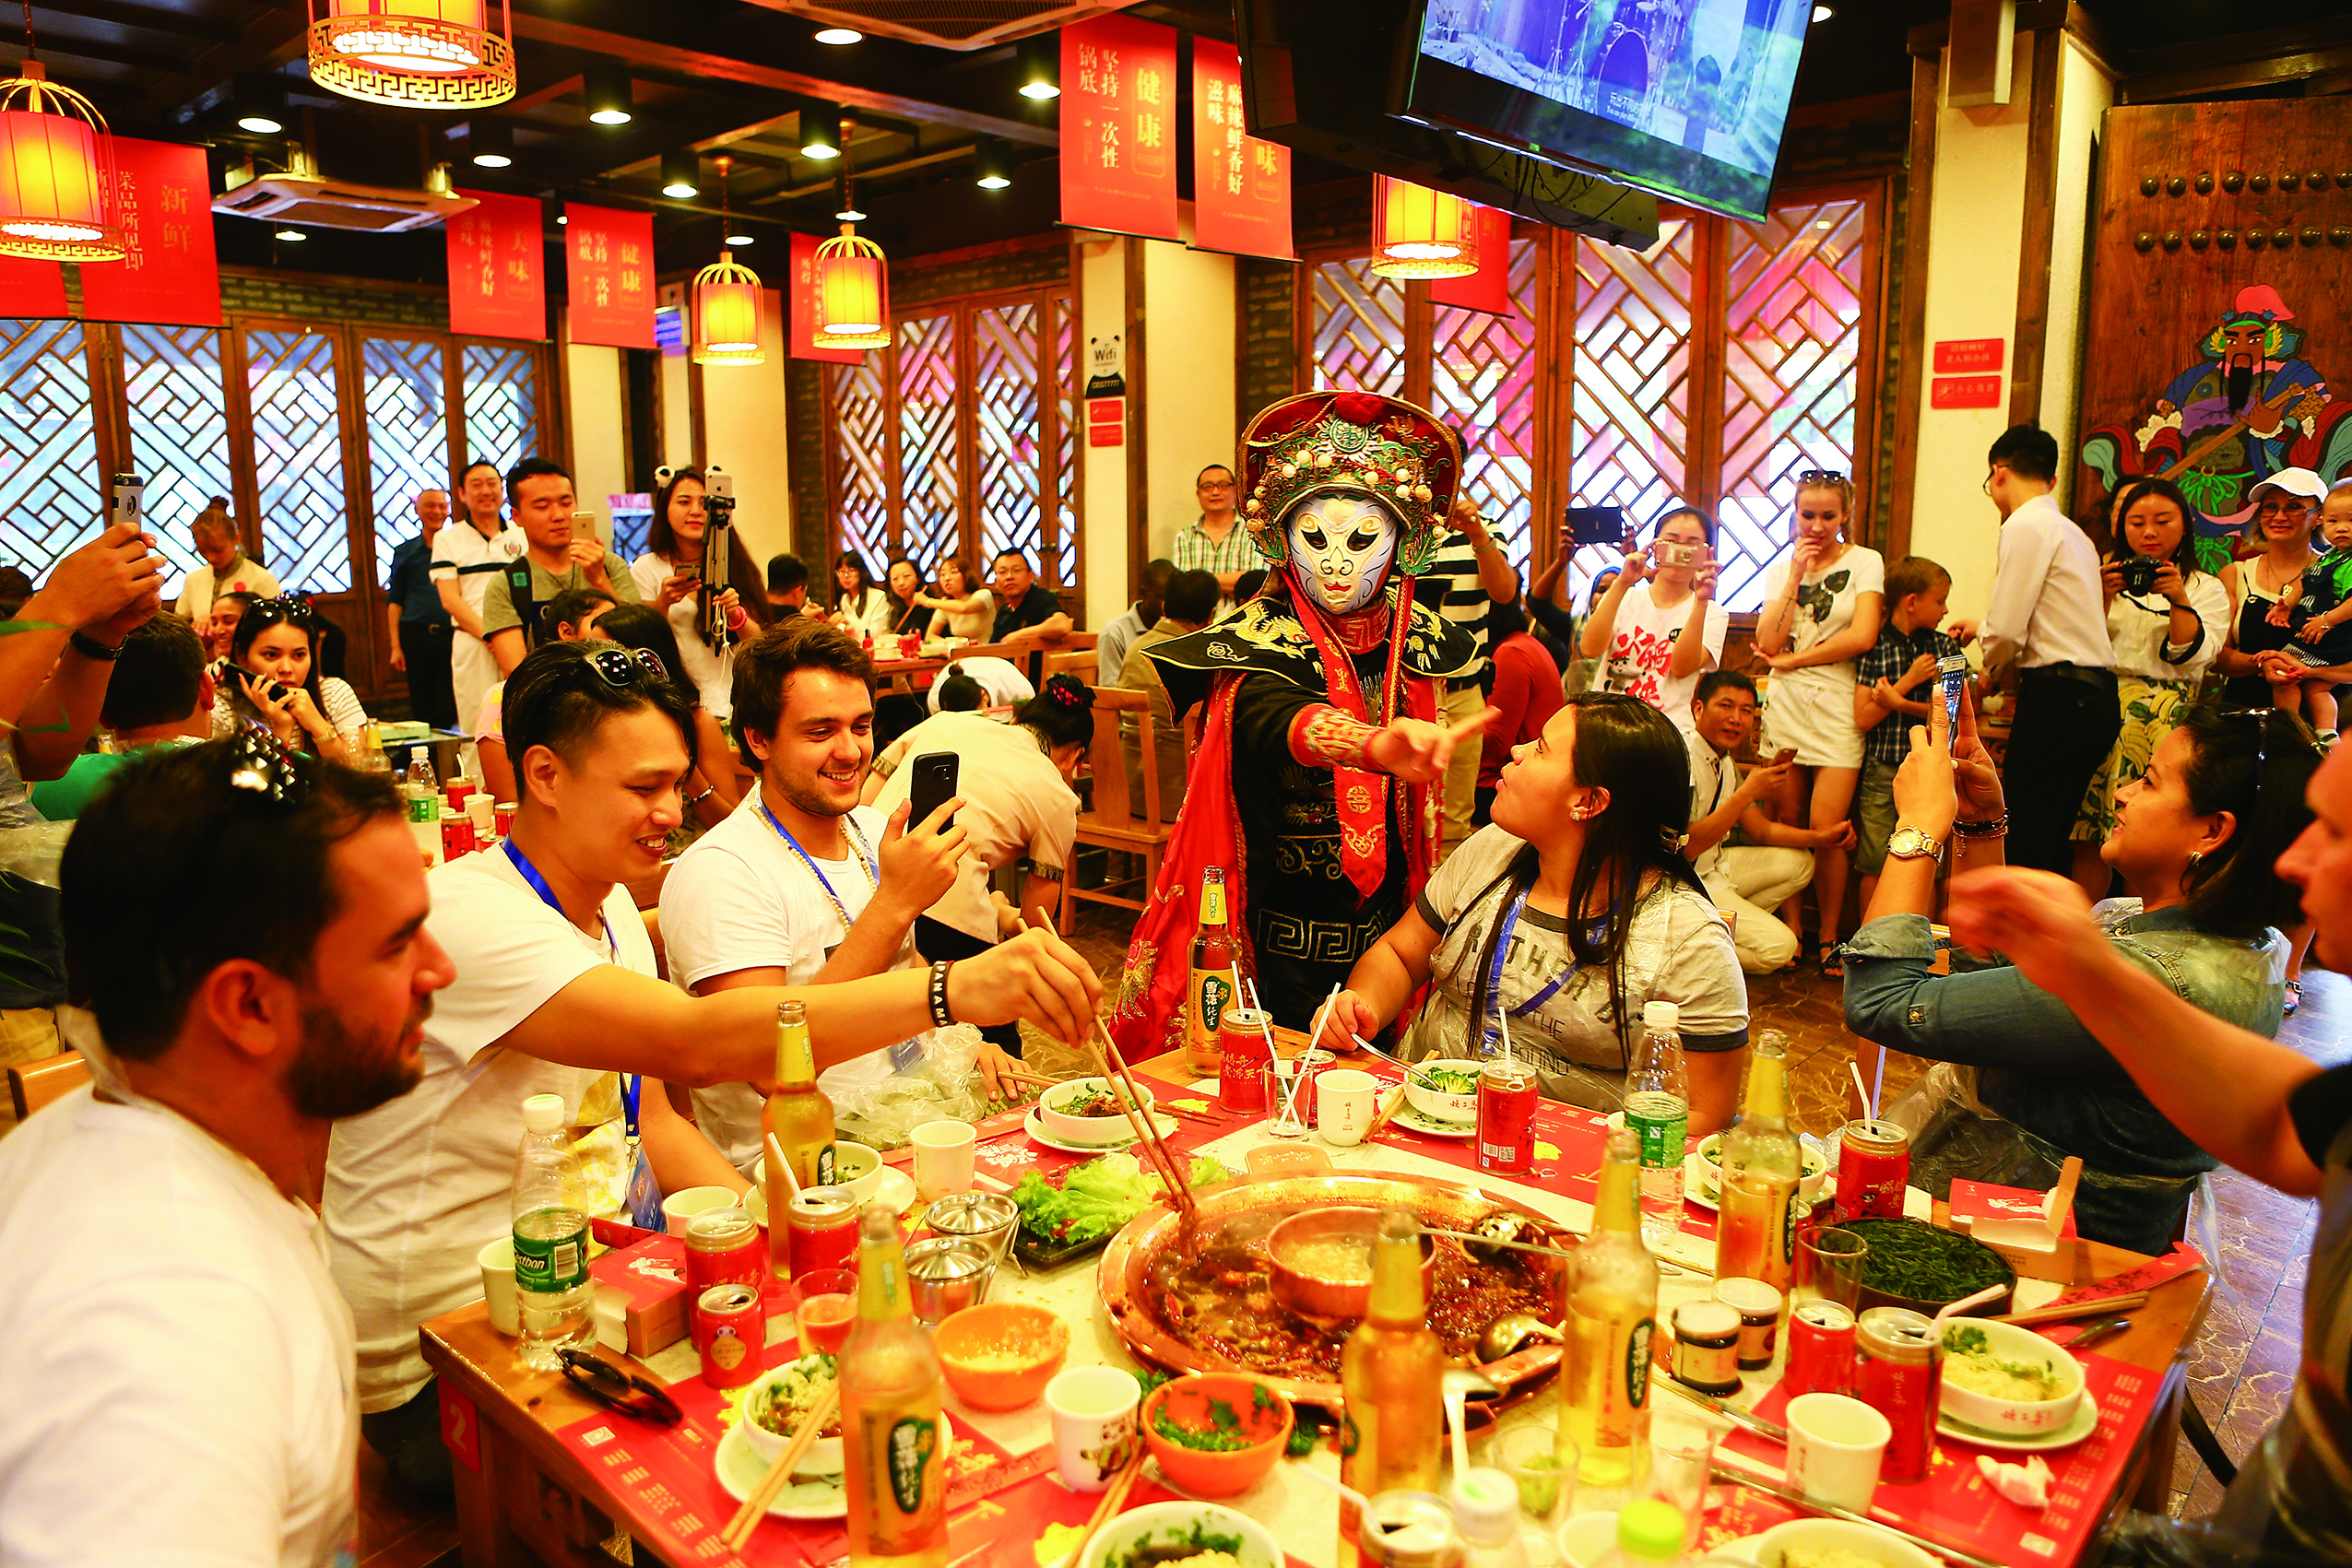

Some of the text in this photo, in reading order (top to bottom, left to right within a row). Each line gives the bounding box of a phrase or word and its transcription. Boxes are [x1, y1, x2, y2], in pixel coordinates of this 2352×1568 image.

[1079, 43, 1097, 94] 锅底
[1101, 49, 1120, 169] 坚持一次性
[1136, 67, 1162, 148] 健康
[1208, 78, 1225, 125] 滋味
[117, 170, 144, 272] 菜品所见即
[160, 184, 192, 252] 新鲜
[621, 242, 642, 292] 健康
[1094, 348, 1117, 361] Wifi
[1470, 924, 1590, 1002] RTHER
[1205, 981, 1218, 1027] 雪花纯生
[1531, 1008, 1566, 1043] THE
